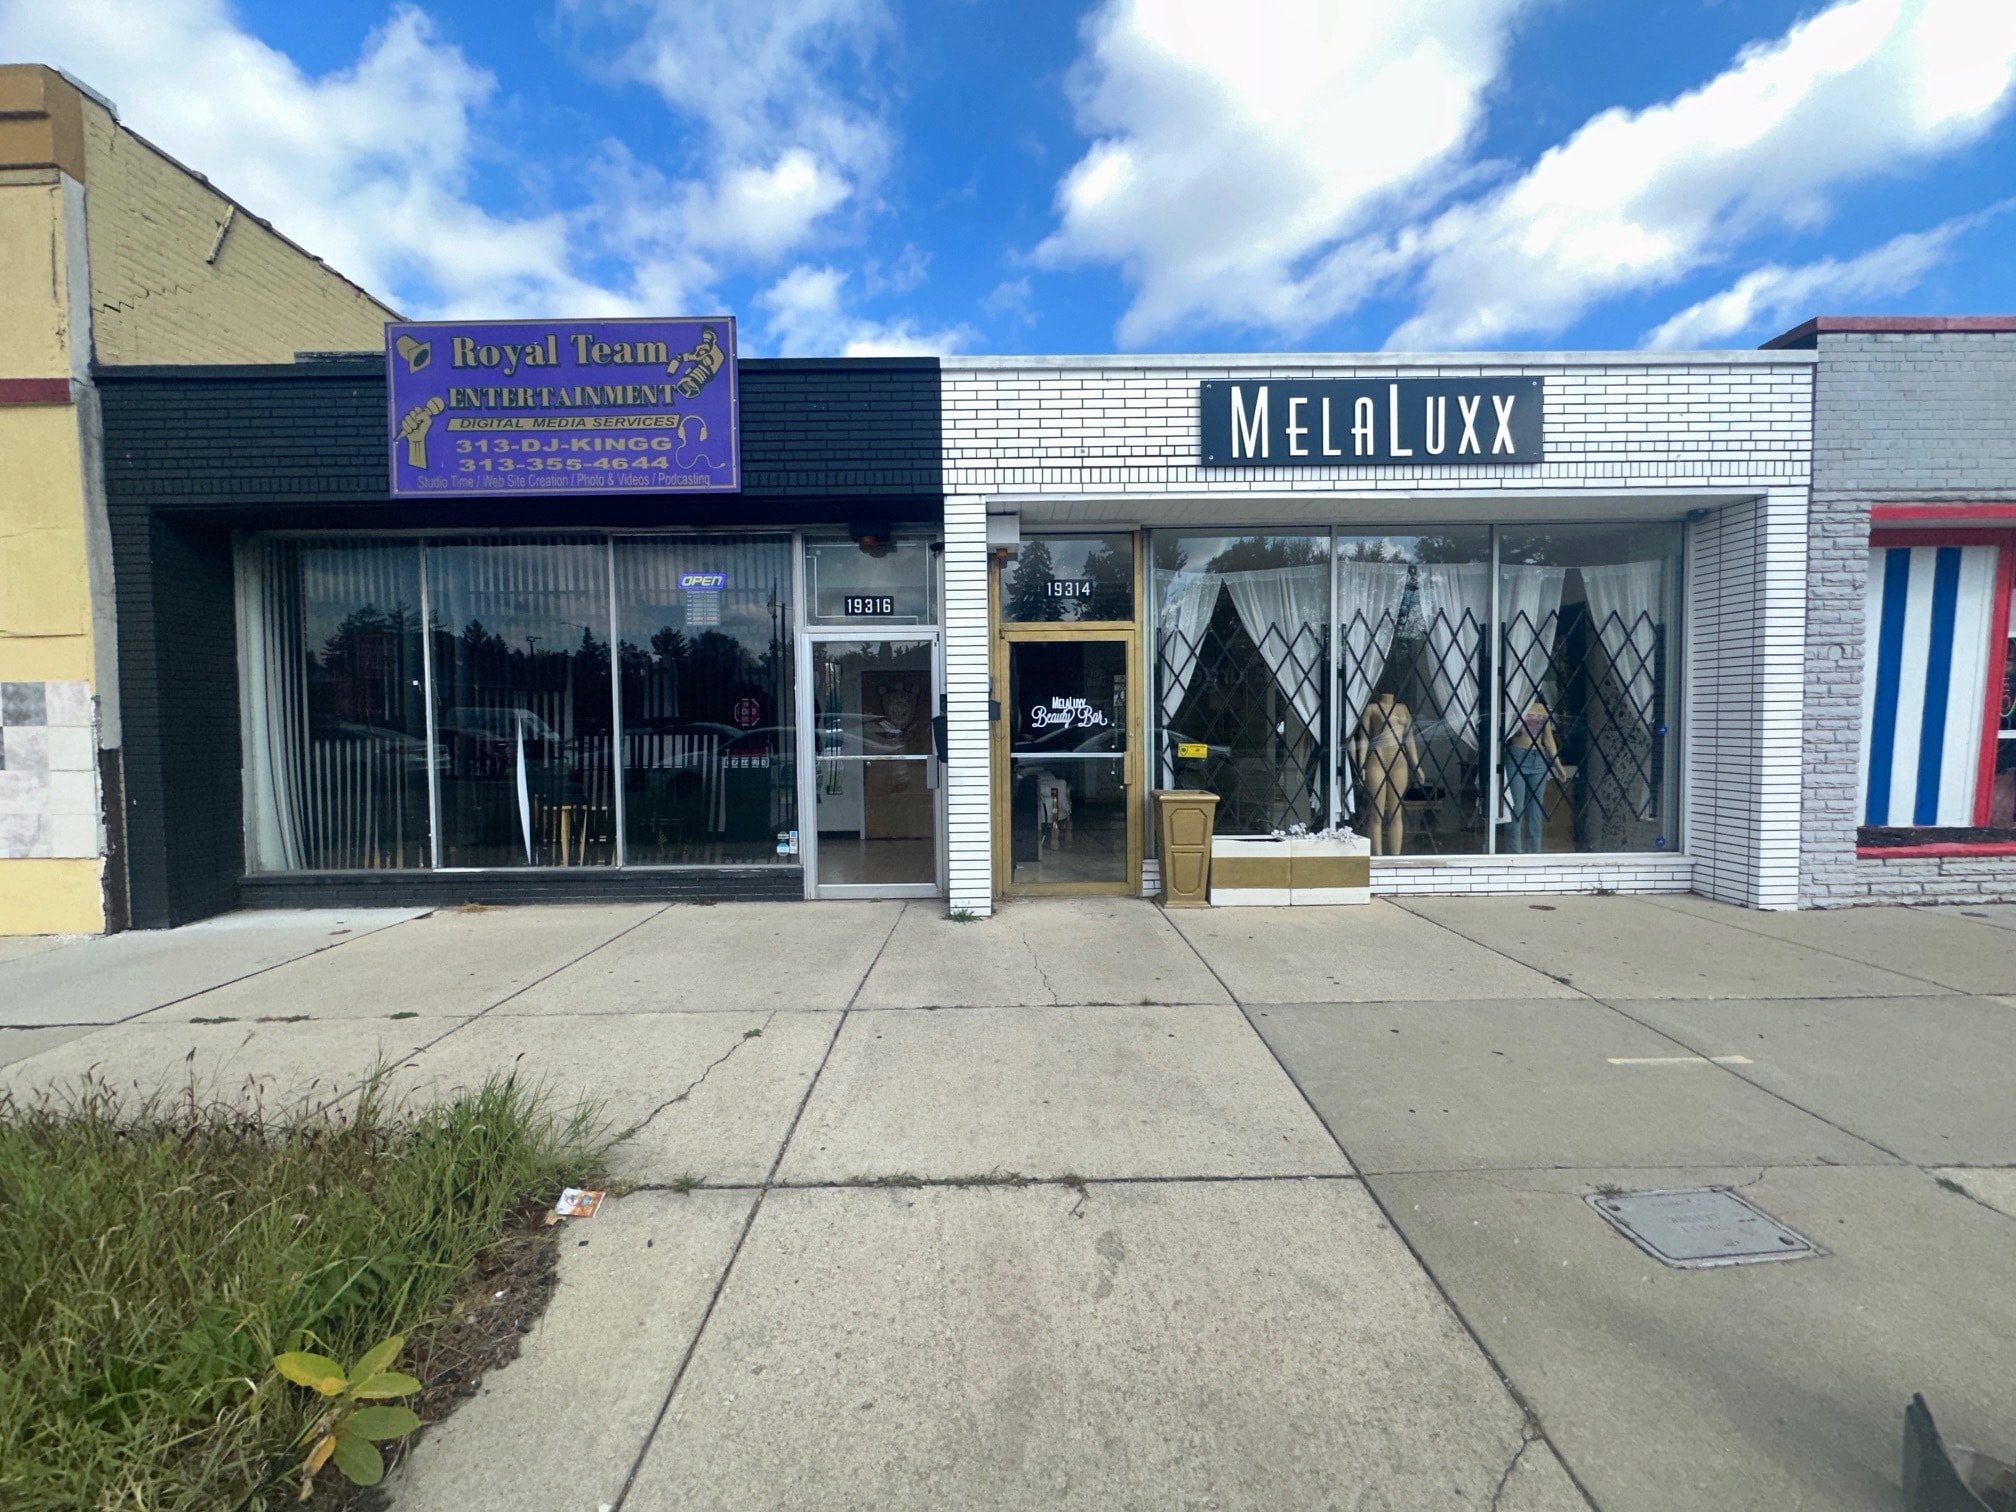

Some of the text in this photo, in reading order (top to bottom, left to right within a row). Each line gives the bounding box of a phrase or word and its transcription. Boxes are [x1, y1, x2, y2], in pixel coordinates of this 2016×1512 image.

[451, 334, 668, 376] Royal Team
[448, 384, 677, 410] ENTERTAINMENT
[460, 416, 676, 429] DIGITAL MEDIA SERVICES
[455, 436, 673, 453] 313-DJ-KINGG
[458, 456, 670, 472] 313-355-4644
[417, 475, 448, 489] Studio
[451, 475, 474, 489] Time
[482, 474, 505, 488] Web
[507, 474, 526, 488] Site
[528, 473, 569, 488] Creation
[577, 473, 604, 487] Photo
[607, 473, 615, 486] &
[617, 472, 650, 486] Videos
[658, 472, 711, 488] Podcasting
[681, 575, 723, 587] OPEN
[1047, 581, 1091, 597] 19314
[847, 598, 891, 614] 19316
[1031, 705, 1108, 729] Beauty Bar
